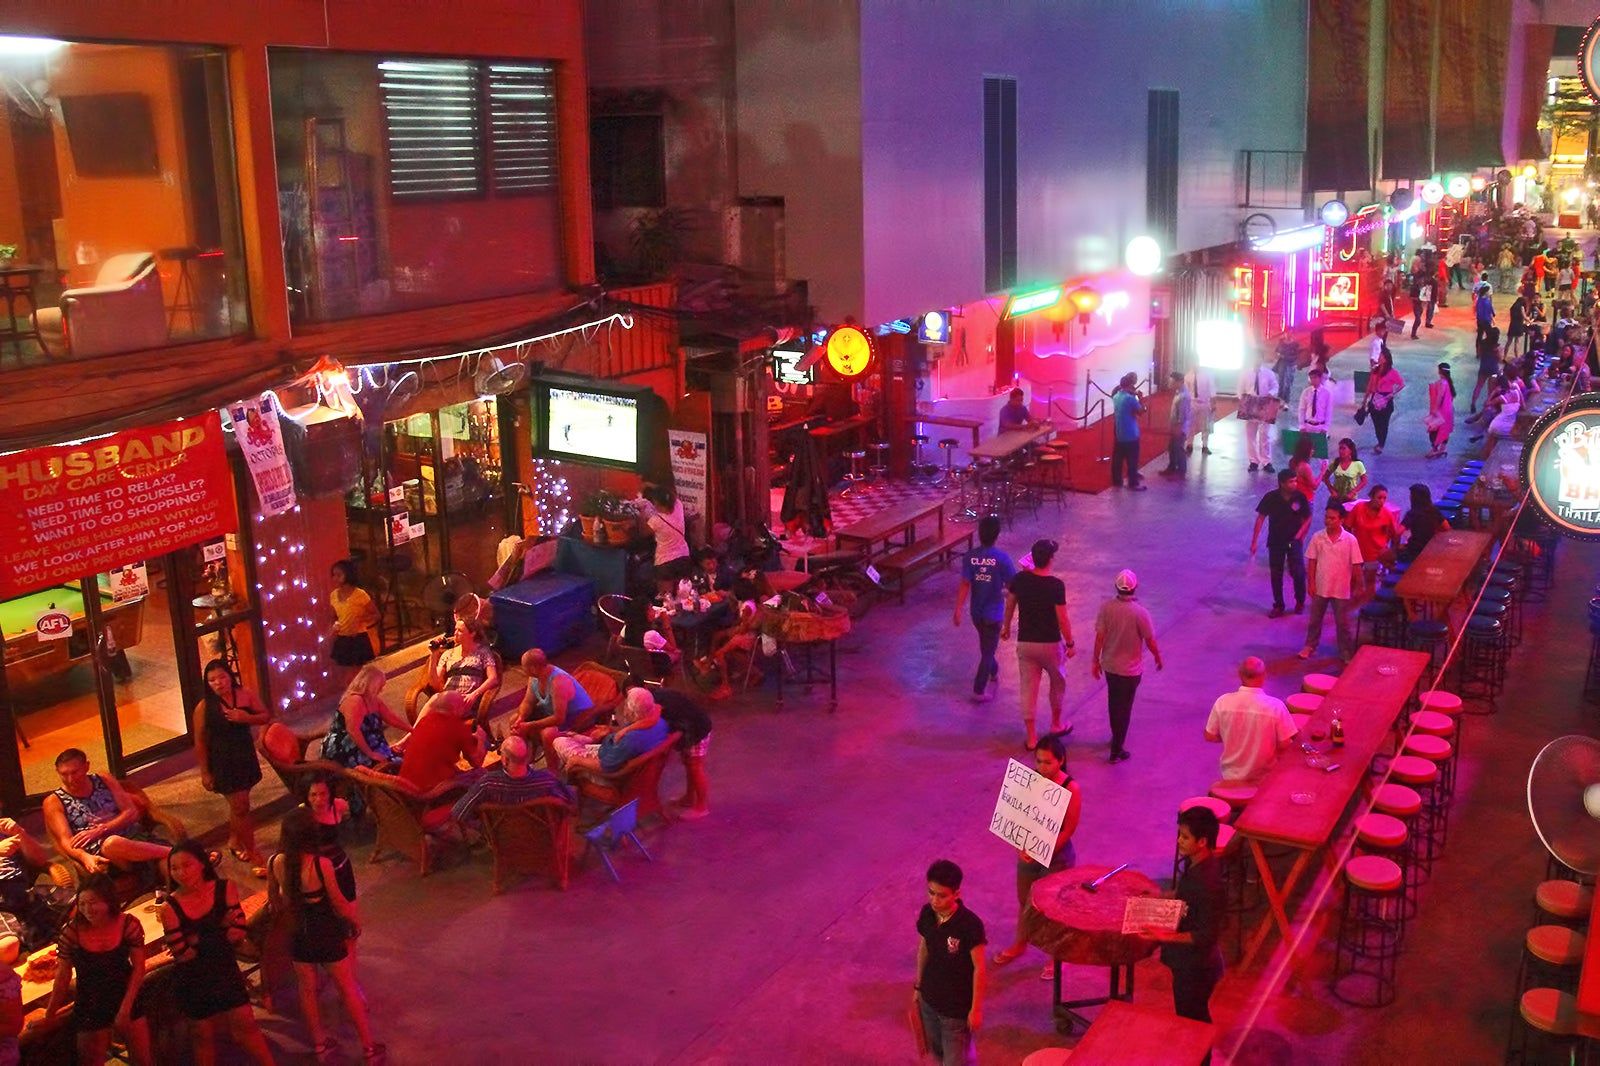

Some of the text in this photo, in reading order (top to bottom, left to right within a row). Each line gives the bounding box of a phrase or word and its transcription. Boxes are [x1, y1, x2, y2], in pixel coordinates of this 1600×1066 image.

[0, 426, 205, 490] HUSBAND
[23, 453, 187, 500] DAY CARE CENTER
[27, 473, 176, 517] NEED TIME TO RELAX?
[31, 479, 205, 530] NEED TIME TO YOURSELF?
[34, 491, 206, 543] WANT TO GO SHOPPING?
[4, 546, 50, 563] LEAVE
[54, 536, 90, 551] YOUR
[93, 516, 159, 542] HUSBAND
[164, 508, 199, 521] WITH
[13, 561, 38, 573] WE
[43, 551, 84, 567] LOOK
[86, 538, 125, 556] AFTER
[129, 530, 156, 543] HIM
[160, 521, 186, 535] FOR
[14, 572, 47, 586] YOU
[52, 561, 89, 577] ONLY
[92, 554, 115, 568] PAY
[119, 545, 144, 559] FOR
[148, 537, 171, 550] HIS
[970, 557, 996, 566] CLASS
[40, 616, 69, 630] AFL
[1008, 762, 1037, 792] BEER
[992, 812, 1051, 861] BUCKET 200
[1023, 804, 1031, 817] 4
[1046, 817, 1060, 836] 100
